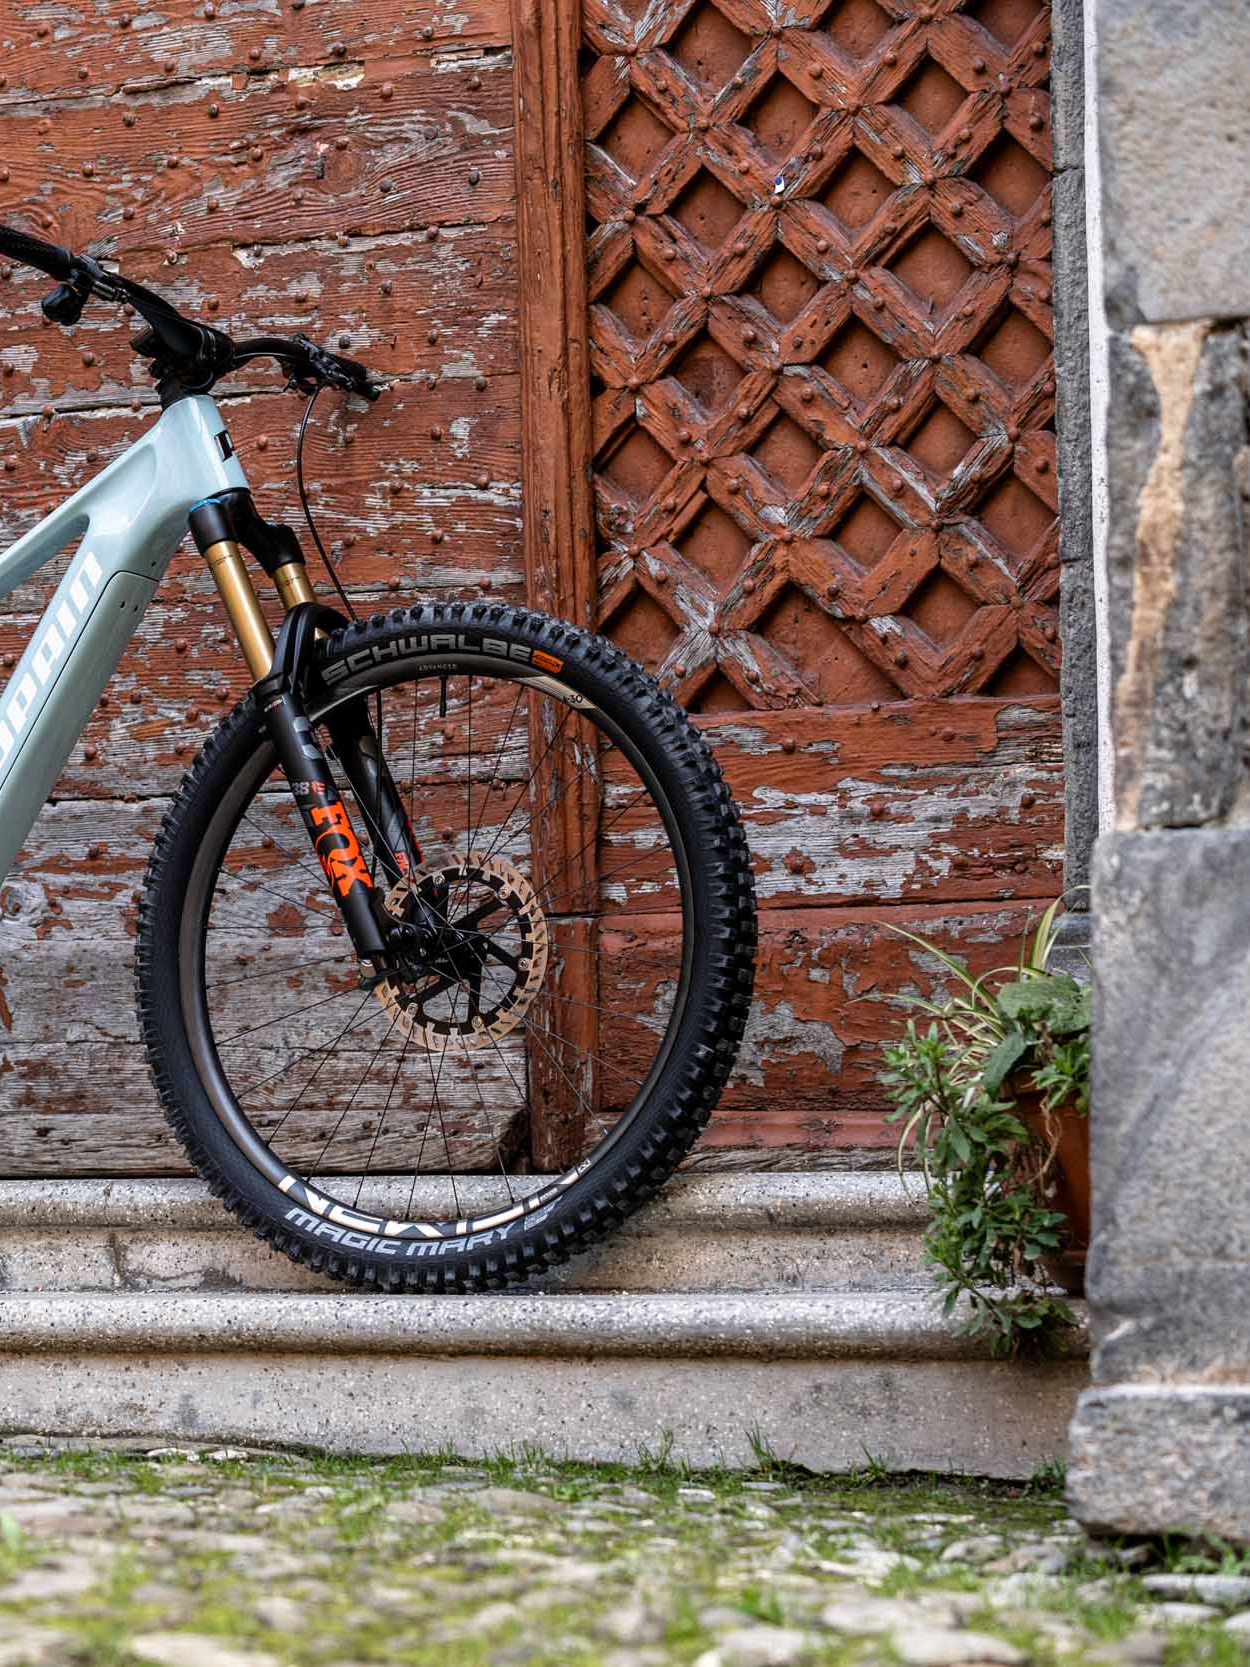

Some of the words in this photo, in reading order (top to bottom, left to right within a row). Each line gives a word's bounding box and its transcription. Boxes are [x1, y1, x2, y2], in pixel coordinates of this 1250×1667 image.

[321, 634, 530, 686] SCHWALBE
[309, 801, 375, 897] FOX
[284, 1207, 399, 1255] MAGIC
[405, 1221, 519, 1257] MARY
